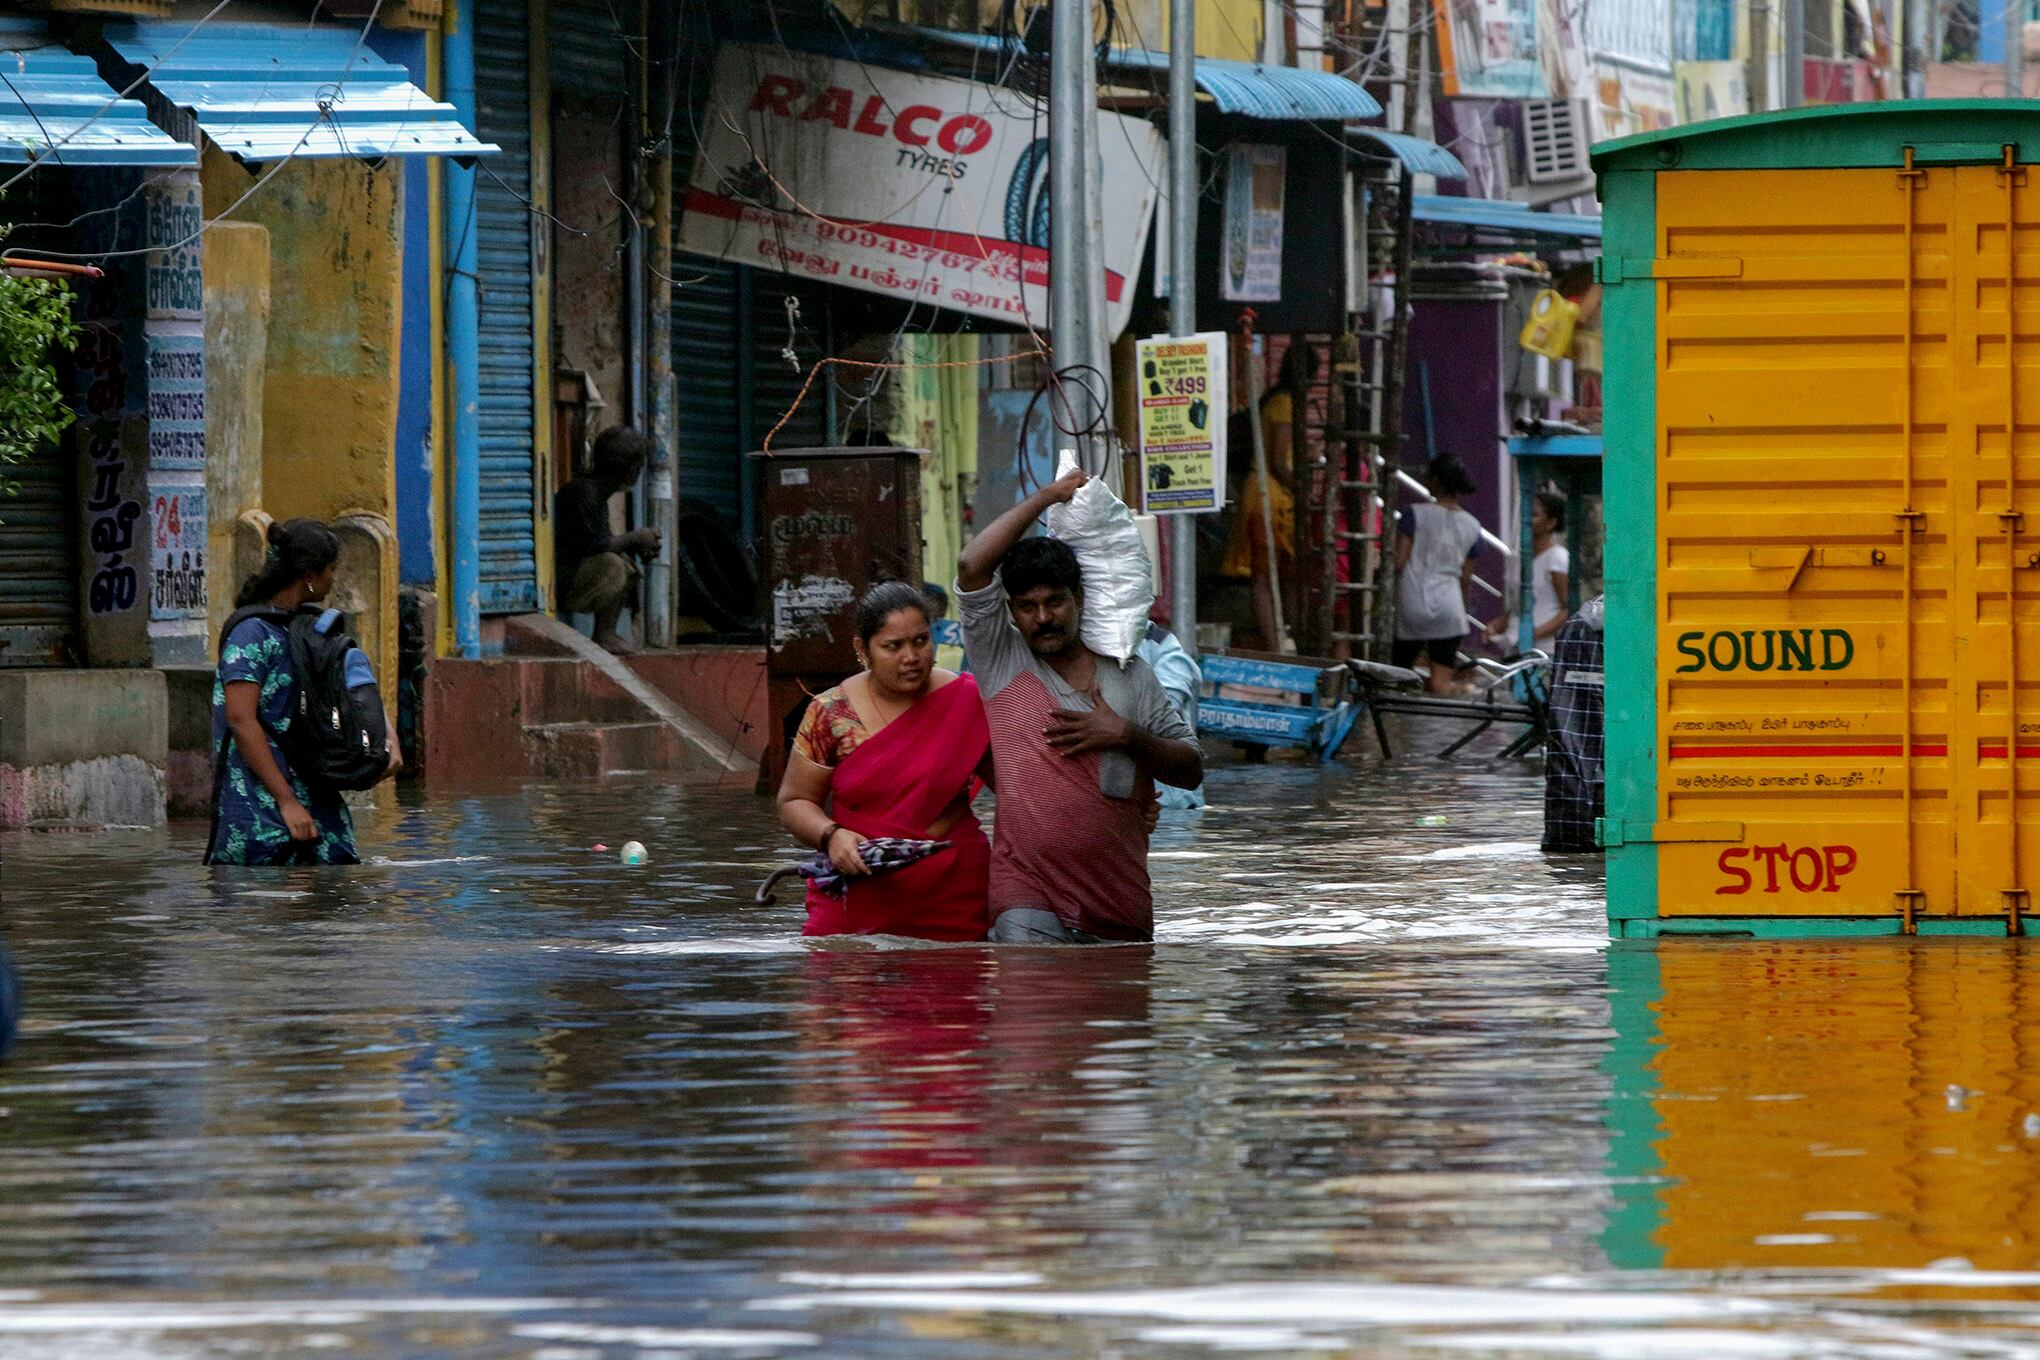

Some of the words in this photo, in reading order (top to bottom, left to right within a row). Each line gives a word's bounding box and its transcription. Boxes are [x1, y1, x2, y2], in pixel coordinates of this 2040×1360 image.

[750, 74, 992, 155] RALCO
[896, 149, 968, 178] TYRES
[1165, 376, 1206, 395] ₹499
[1184, 464, 1196, 473] Get
[155, 495, 181, 548] 24
[1676, 629, 1854, 673] SOUND
[1715, 842, 1857, 895] STOP
